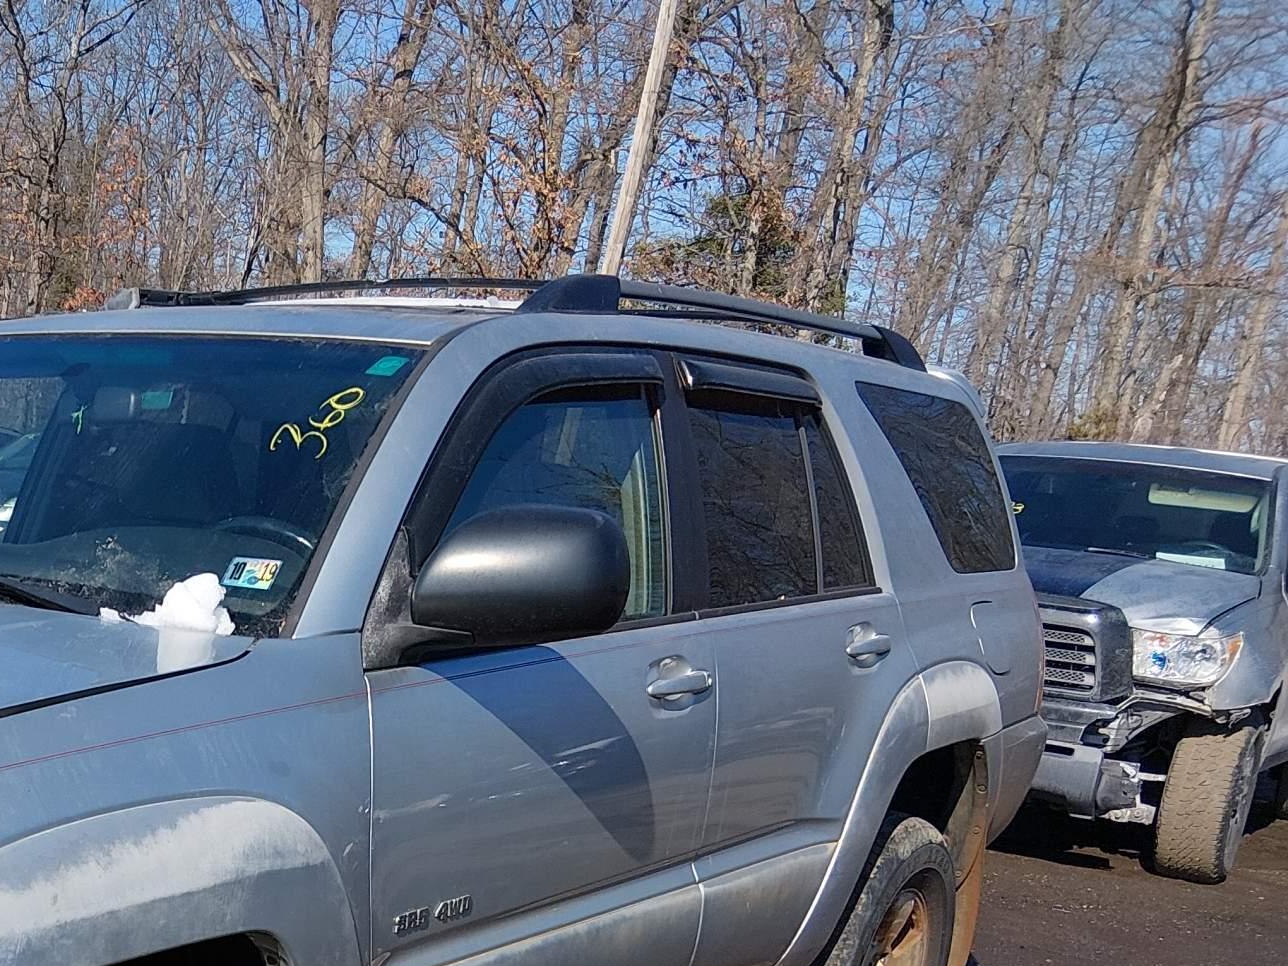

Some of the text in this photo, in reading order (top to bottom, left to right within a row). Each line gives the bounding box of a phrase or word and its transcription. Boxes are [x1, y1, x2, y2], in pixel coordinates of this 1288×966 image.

[269, 386, 367, 460] 360
[229, 561, 279, 582] 10 19
[433, 894, 473, 922] 4WD
